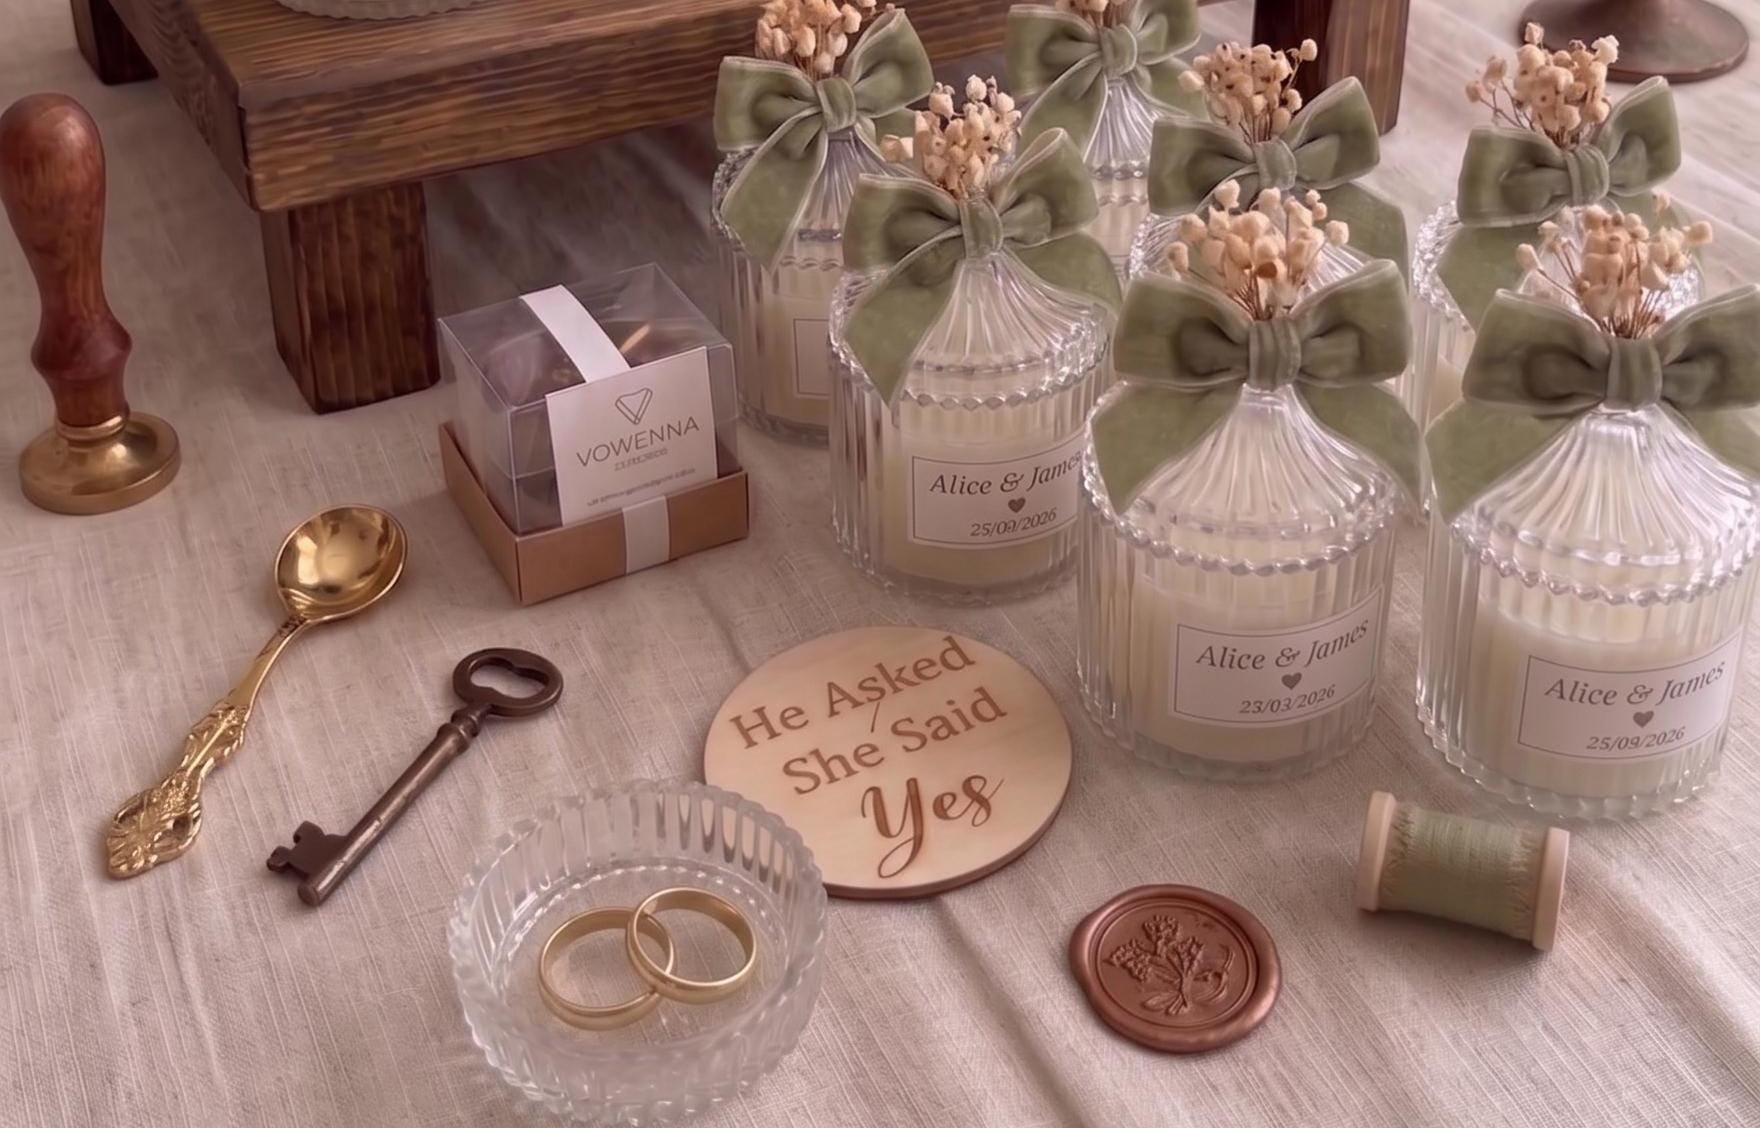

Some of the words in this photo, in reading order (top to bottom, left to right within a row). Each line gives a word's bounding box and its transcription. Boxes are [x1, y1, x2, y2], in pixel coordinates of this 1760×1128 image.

[576, 416, 700, 467] VOWENNA
[929, 474, 992, 496] Alice
[1000, 472, 1025, 492] &
[1196, 646, 1265, 670] Alice
[1275, 647, 1301, 668] &
[1304, 619, 1369, 668] James
[729, 704, 810, 749] He
[825, 635, 976, 719] Asked
[1239, 684, 1336, 714] 23/03/2026
[1544, 678, 1618, 706] Alice
[1627, 684, 1653, 705] &
[1655, 661, 1726, 706] James
[782, 741, 885, 795] She
[890, 686, 1008, 753] Said
[1586, 726, 1686, 752] 25/09/2026
[861, 774, 1004, 878] Yes
